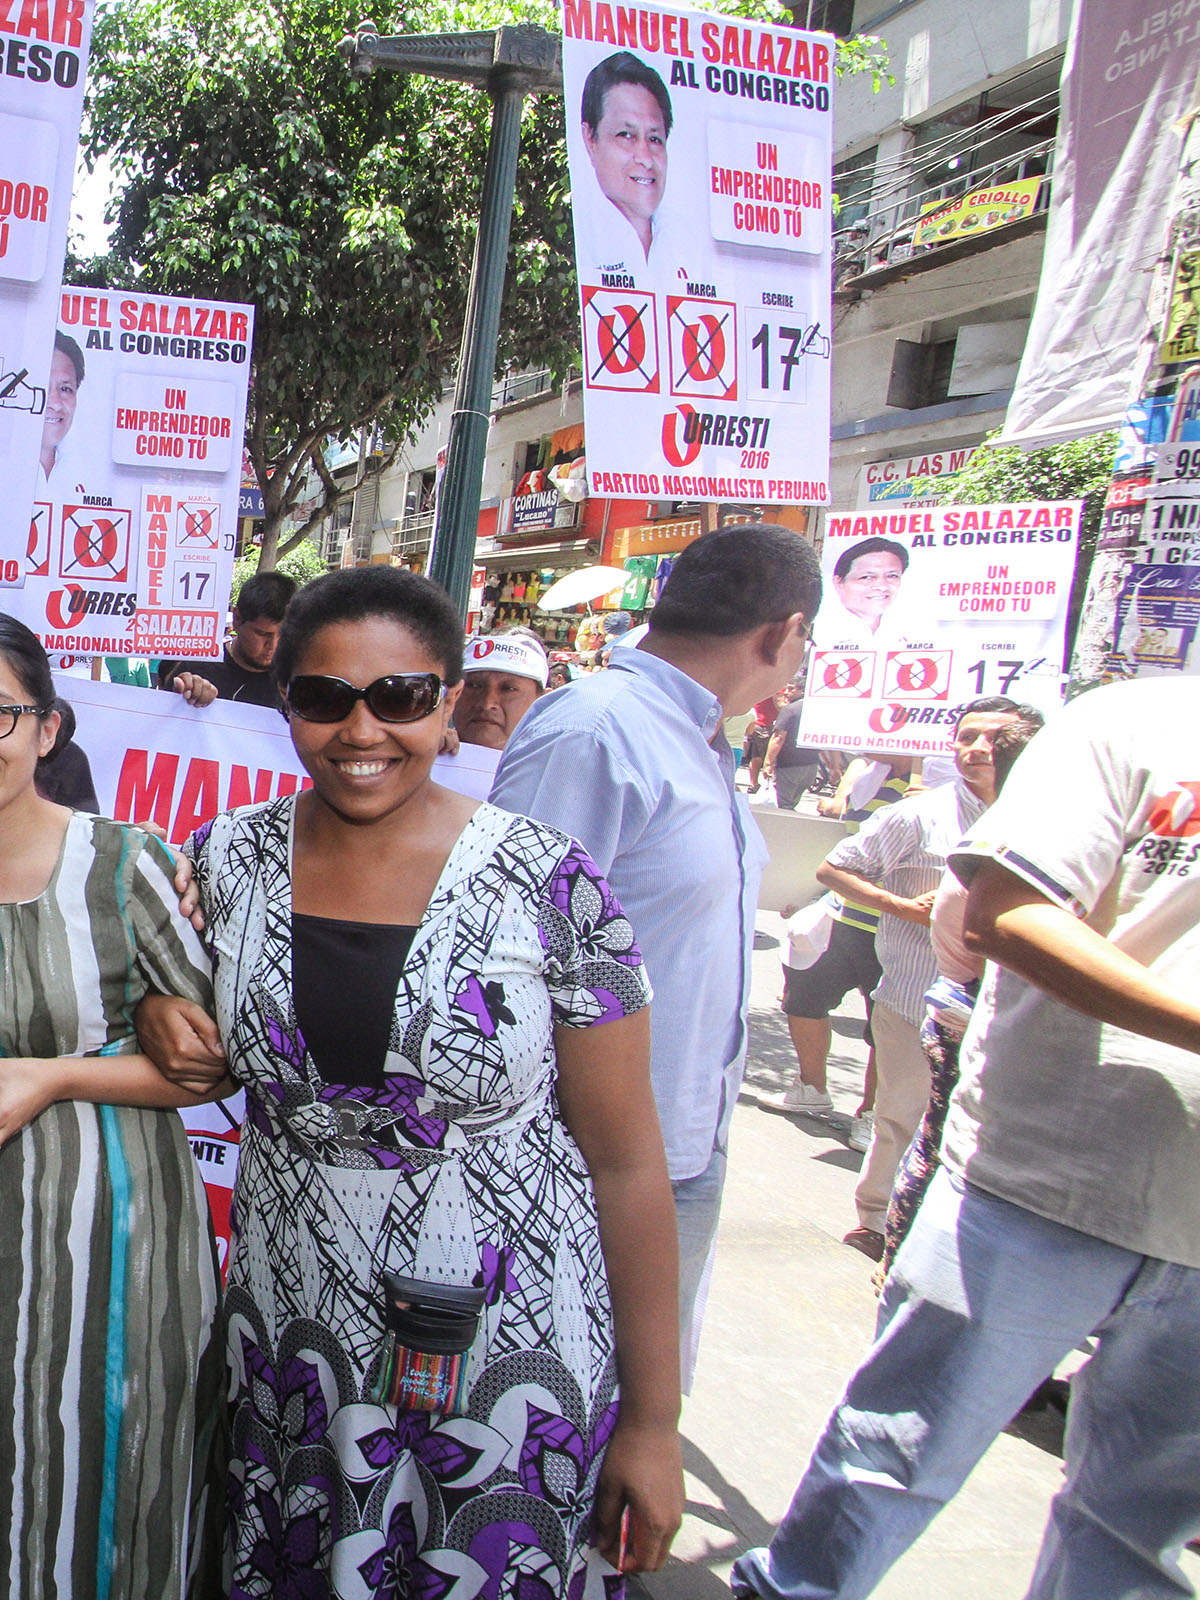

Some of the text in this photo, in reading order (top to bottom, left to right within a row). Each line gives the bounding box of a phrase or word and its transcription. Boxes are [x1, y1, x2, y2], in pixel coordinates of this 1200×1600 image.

[564, 0, 830, 83] MANUEL SALAZAR
[670, 60, 830, 112] AL CONGRESO
[756, 142, 778, 171] UN
[711, 166, 822, 209] EMPRENDEDOR
[968, 191, 1031, 206] CRIOLLO
[733, 202, 802, 238] COMO TÚ
[601, 273, 636, 289] MARCA
[686, 283, 717, 298] MARCA
[762, 292, 794, 308] ESCRIBE
[119, 300, 249, 342] SALAZAR
[86, 330, 247, 364] AL CONGRESO
[752, 323, 802, 391] 17
[164, 388, 187, 411] UN
[116, 408, 231, 439] EMPRENDEDOR
[136, 434, 208, 461] COMO TÚ
[741, 450, 770, 470] 2016
[866, 462, 899, 484] C.C.
[906, 454, 943, 479] LAS
[592, 472, 827, 501] PARTIDO NACIONALISTA PERUANO
[82, 495, 113, 508] MARCA
[515, 489, 558, 511] CORTINAS
[828, 507, 1073, 537] MANUEL SALAZAR
[911, 528, 1072, 547] AL CONGRESO
[146, 494, 172, 606] MANUEL
[987, 565, 1009, 579] UN
[179, 571, 210, 600] 17
[939, 580, 1056, 597] EMPRENDEDOR
[959, 595, 1031, 612] COMO TÚ
[137, 613, 215, 637] SALAZAR
[137, 637, 212, 649] AL CONGRESO
[906, 642, 934, 650] MARCA
[967, 660, 1025, 695] 17
[802, 733, 862, 747] PARTIDO
[1142, 860, 1191, 877] 2016
[189, 1140, 226, 1165] NTE
